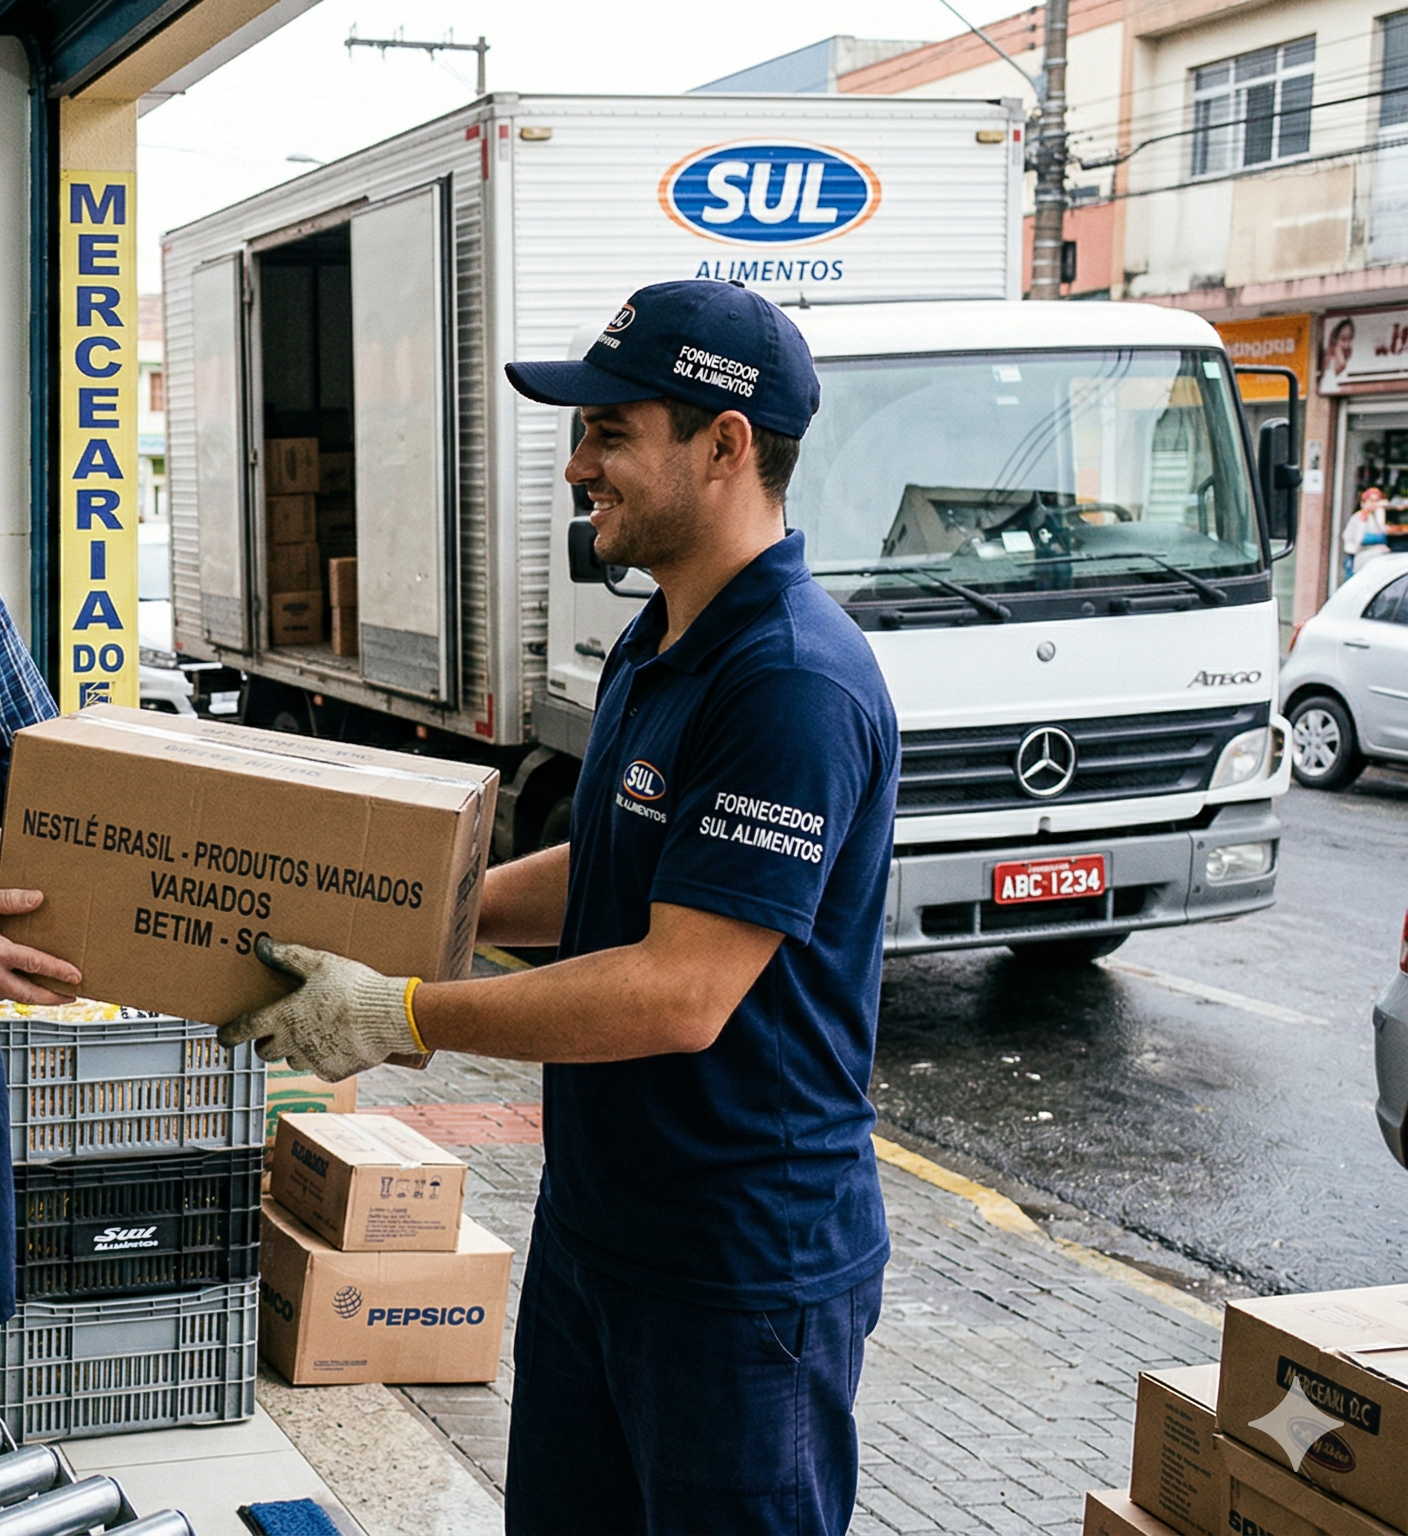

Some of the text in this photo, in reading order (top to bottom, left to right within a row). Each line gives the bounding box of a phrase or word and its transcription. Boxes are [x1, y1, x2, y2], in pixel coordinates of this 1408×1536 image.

[702, 161, 839, 225] SUL
[695, 260, 844, 282] ALIMENTOS
[673, 359, 756, 398] SUL ALIMENTOS
[679, 345, 760, 383] FORNECEDOR
[69, 183, 127, 631] MERCEARIA
[73, 643, 125, 673] DO
[627, 765, 654, 795] SUL
[714, 792, 825, 836] FORNECEDOR
[22, 807, 98, 847] NESTLÉ
[103, 823, 176, 863] BRASIL
[194, 841, 309, 888] PRODUTOS
[315, 863, 424, 909] VARIADOS
[699, 815, 824, 863] SUL ALIMENTOS
[150, 870, 272, 920] VARIADOS
[1002, 868, 1101, 899] ABC 1234
[134, 908, 214, 949] BETIM
[367, 1304, 486, 1327] PEPSICO
